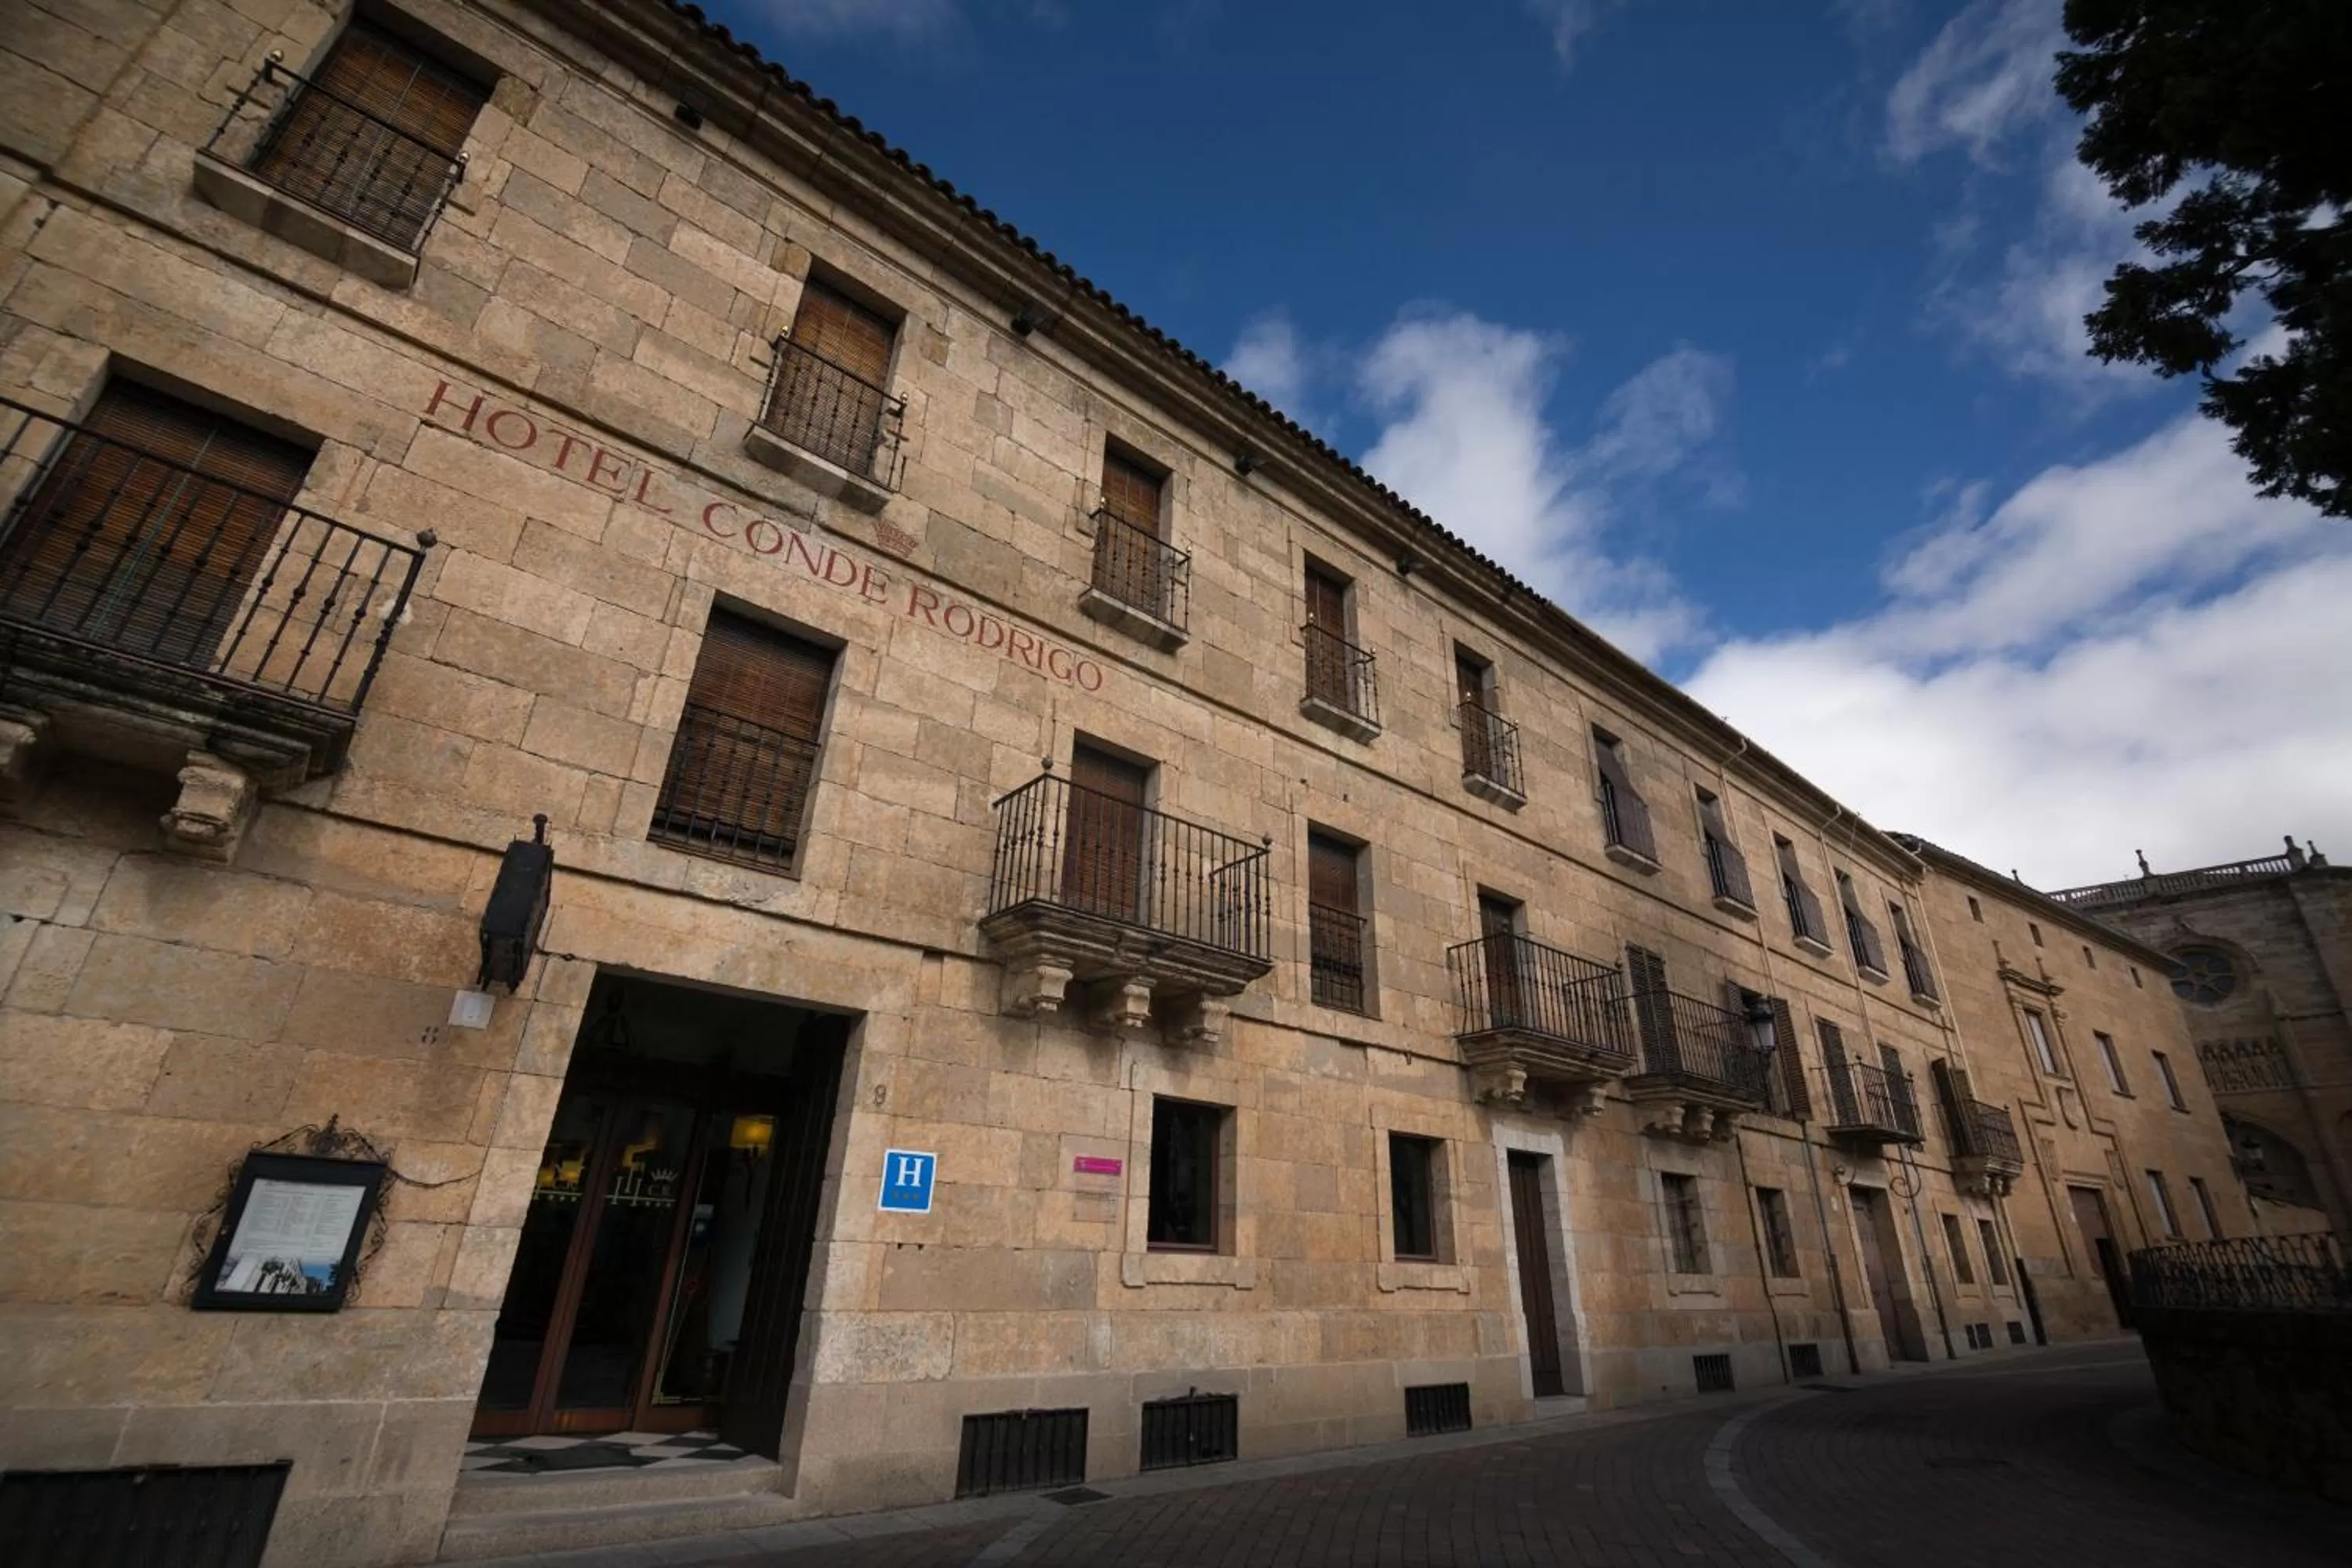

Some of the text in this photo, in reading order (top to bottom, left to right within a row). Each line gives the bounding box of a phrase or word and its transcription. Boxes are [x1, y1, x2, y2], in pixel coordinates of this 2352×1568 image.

[423, 379, 1103, 692] HOTEL CONDE RODRIGO
[895, 1156, 924, 1187] H
